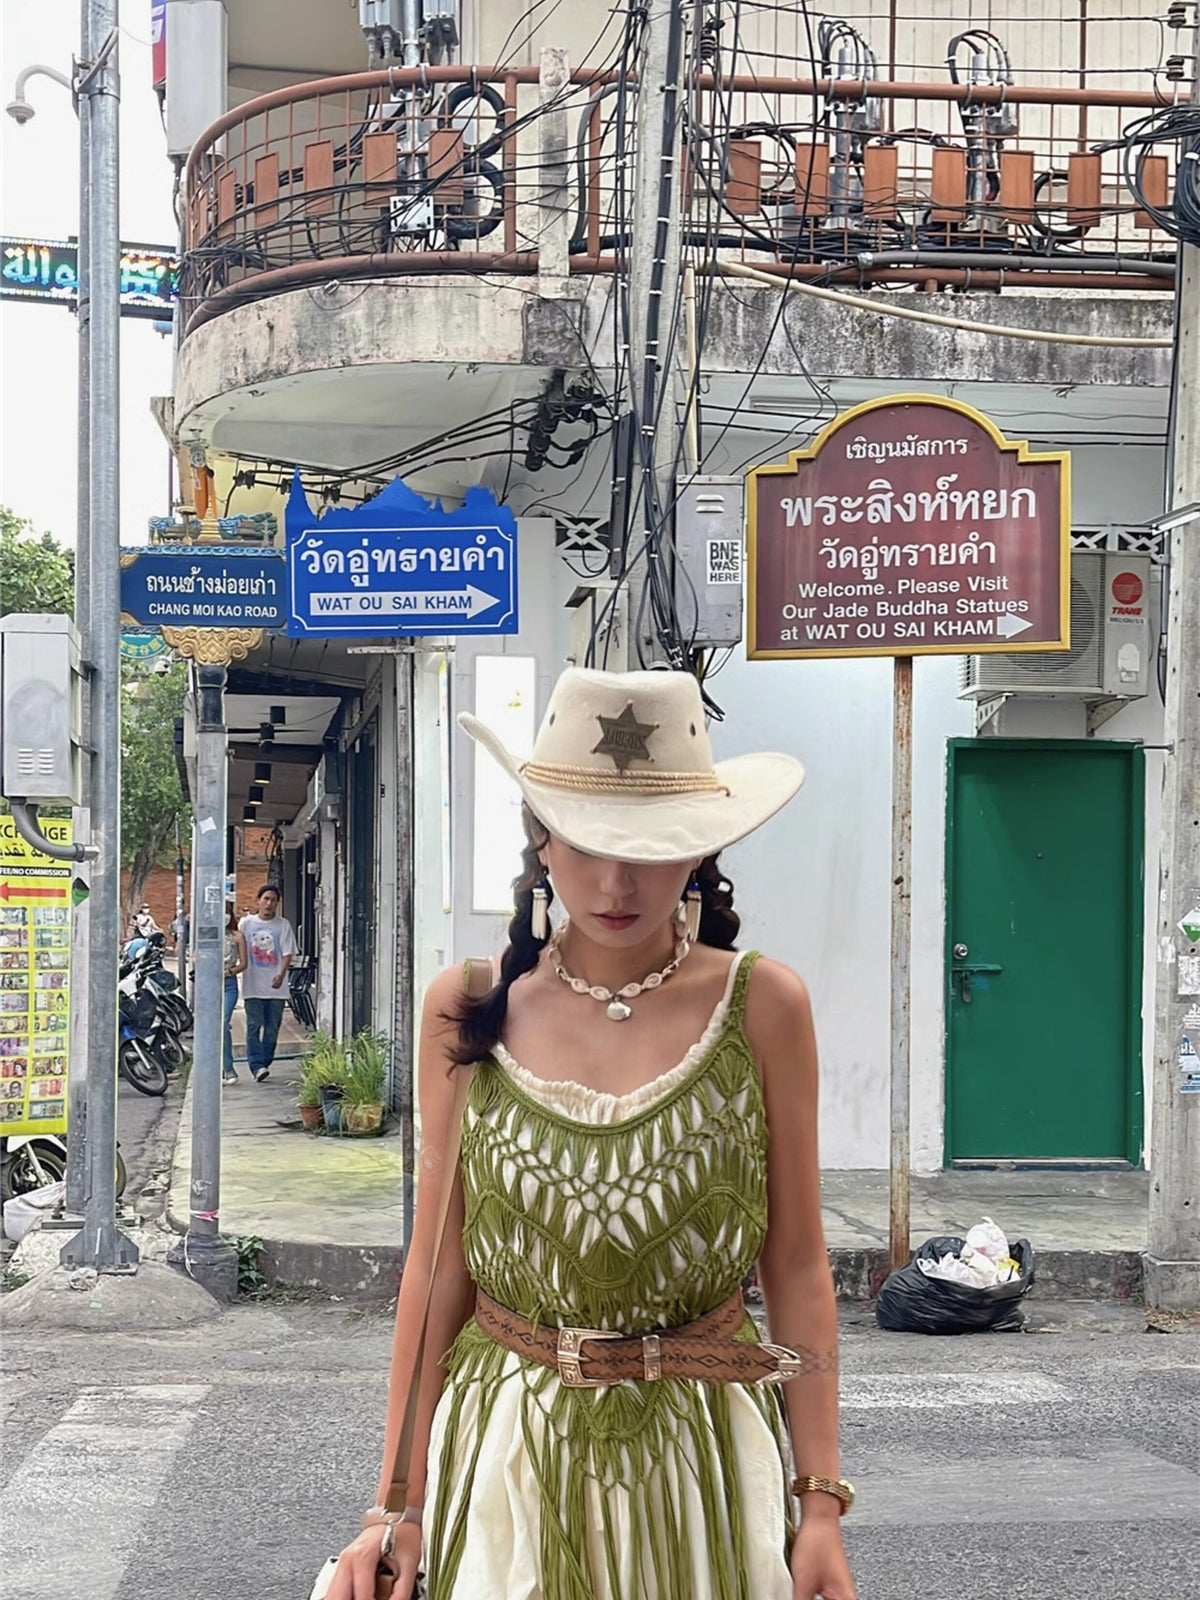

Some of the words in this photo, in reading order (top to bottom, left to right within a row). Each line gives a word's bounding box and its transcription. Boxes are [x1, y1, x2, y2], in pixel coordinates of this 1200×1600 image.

[846, 434, 969, 464] เชิญนมัสการ
[780, 473, 1037, 527] พระสิงห์หยก
[300, 534, 505, 587] วัดอู่ทรายคำ
[710, 542, 739, 560] BNE
[818, 531, 997, 581] วัดอู่ทรายคำ
[710, 560, 739, 571] WAS
[146, 566, 276, 595] ถนนช้างม่อยเก่า
[710, 572, 739, 582] HERE
[898, 579, 960, 594] Please
[967, 575, 1009, 592] Visit
[148, 603, 190, 615] CHANG
[193, 604, 215, 616] MOI
[217, 605, 242, 617] KAO
[244, 606, 278, 618] ROAD
[317, 597, 352, 611] WAT
[359, 597, 382, 610] OU
[392, 596, 417, 610] SAI
[425, 595, 473, 609] KHAM
[782, 603, 817, 619] Our
[823, 602, 869, 618] Jade
[876, 600, 948, 617] Buddha
[956, 598, 1029, 614] Statues
[780, 626, 799, 641] at
[805, 624, 850, 640] WAT
[856, 622, 886, 639] OU
[893, 621, 925, 638] SAI
[933, 619, 994, 637] KHAM
